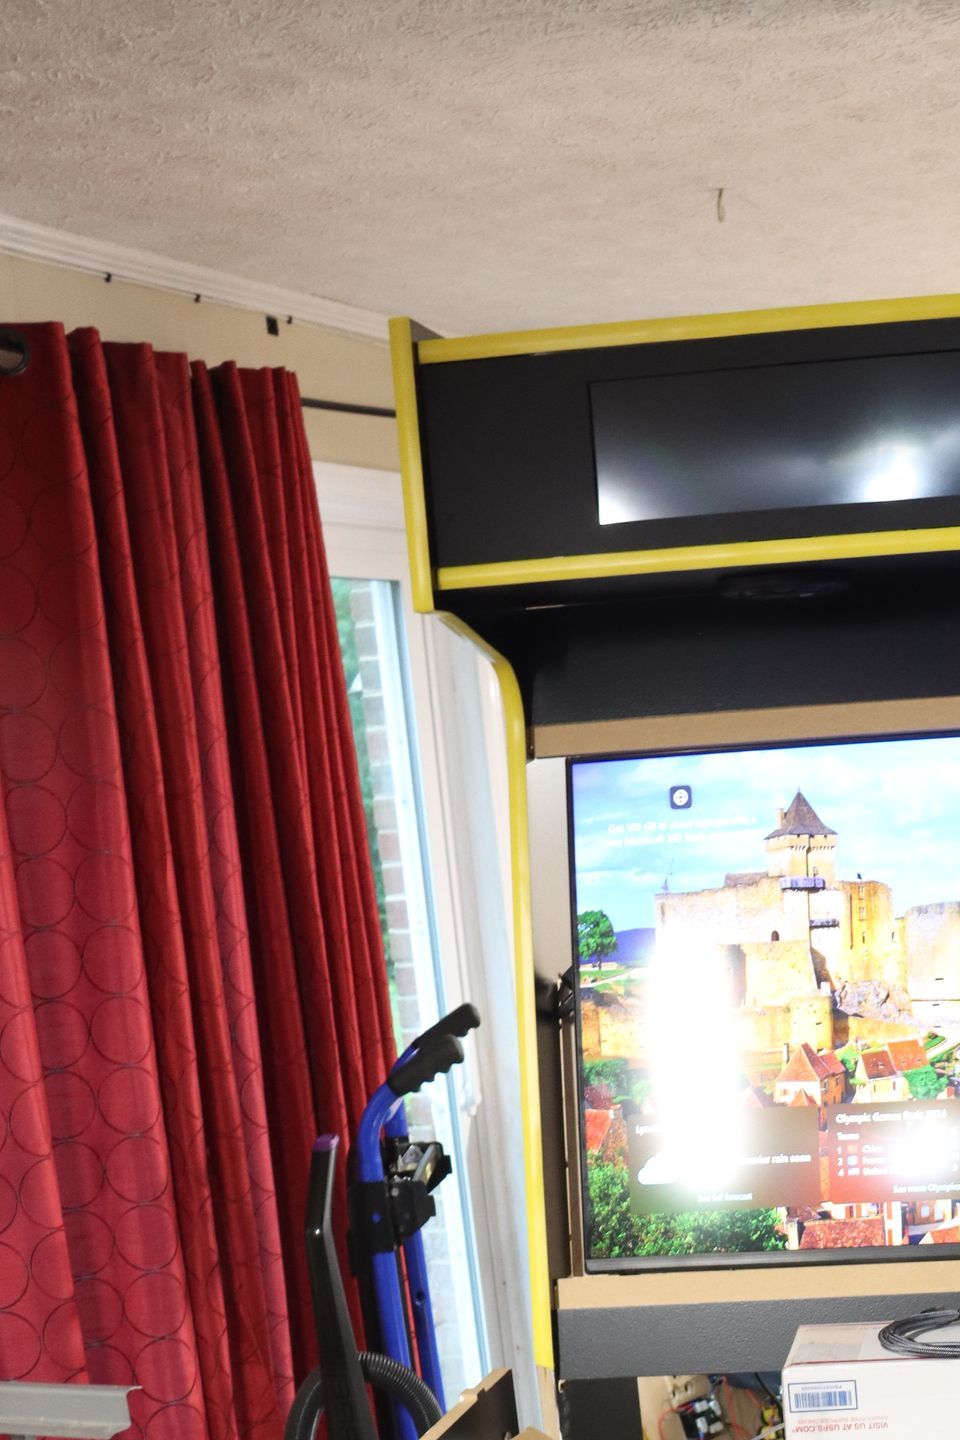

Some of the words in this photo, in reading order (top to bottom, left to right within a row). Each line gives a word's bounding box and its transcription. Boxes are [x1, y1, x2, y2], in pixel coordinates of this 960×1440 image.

[836, 1112, 871, 1125] Olympic
[928, 1183, 960, 1194] Olympics
[842, 1423, 853, 1431] AT
[854, 1422, 866, 1431] US
[868, 1421, 889, 1430] VISIT
